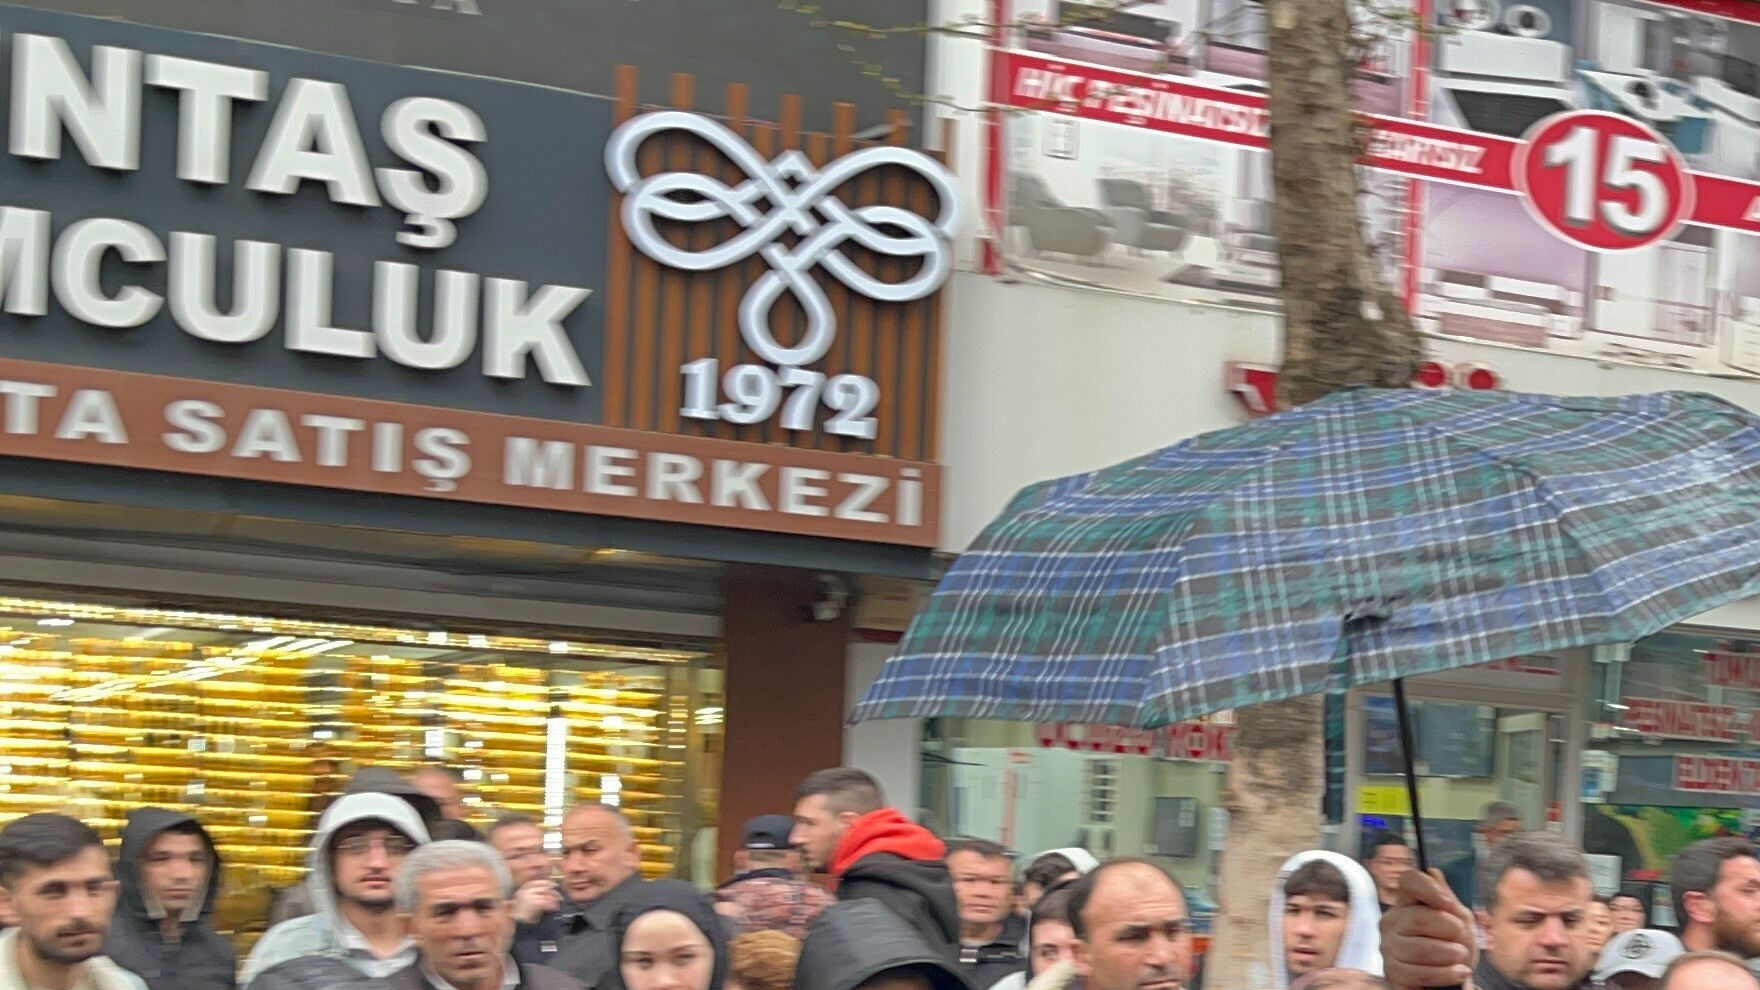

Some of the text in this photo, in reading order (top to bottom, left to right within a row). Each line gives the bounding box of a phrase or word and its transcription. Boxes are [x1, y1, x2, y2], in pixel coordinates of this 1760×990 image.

[8, 33, 489, 249] NTAŞ
[1543, 125, 1671, 236] 15
[0, 378, 924, 528] TA SATIŞ MERKEZİ
[679, 357, 880, 440] 1972
